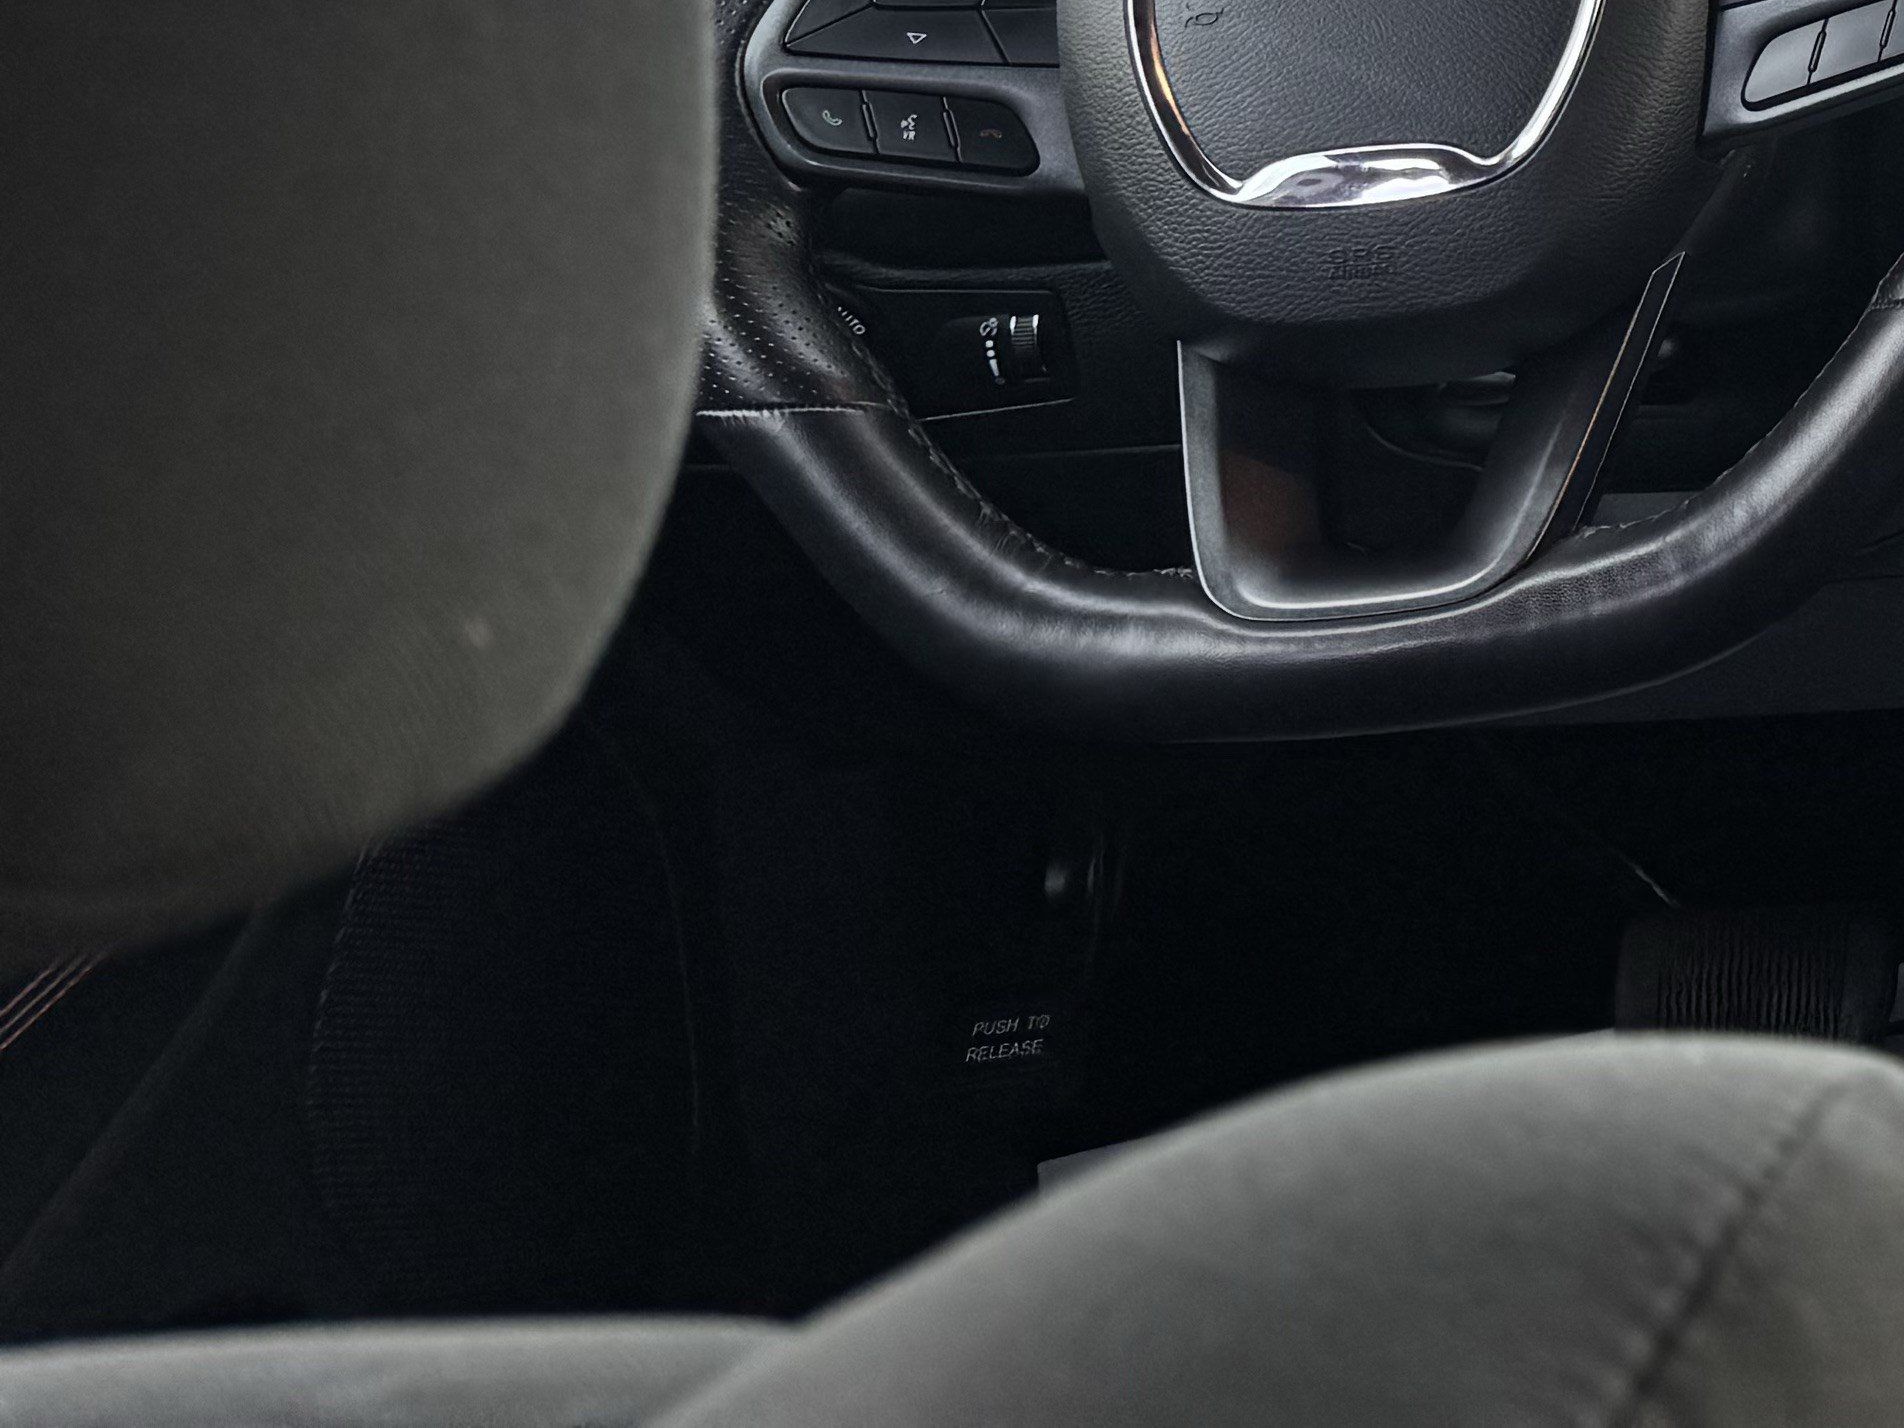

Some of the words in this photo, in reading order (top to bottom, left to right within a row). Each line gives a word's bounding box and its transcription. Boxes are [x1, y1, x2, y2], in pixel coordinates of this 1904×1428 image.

[902, 130, 916, 142] VR
[972, 1017, 1020, 1037] PUSH
[965, 1039, 1044, 1063] RELEASE
